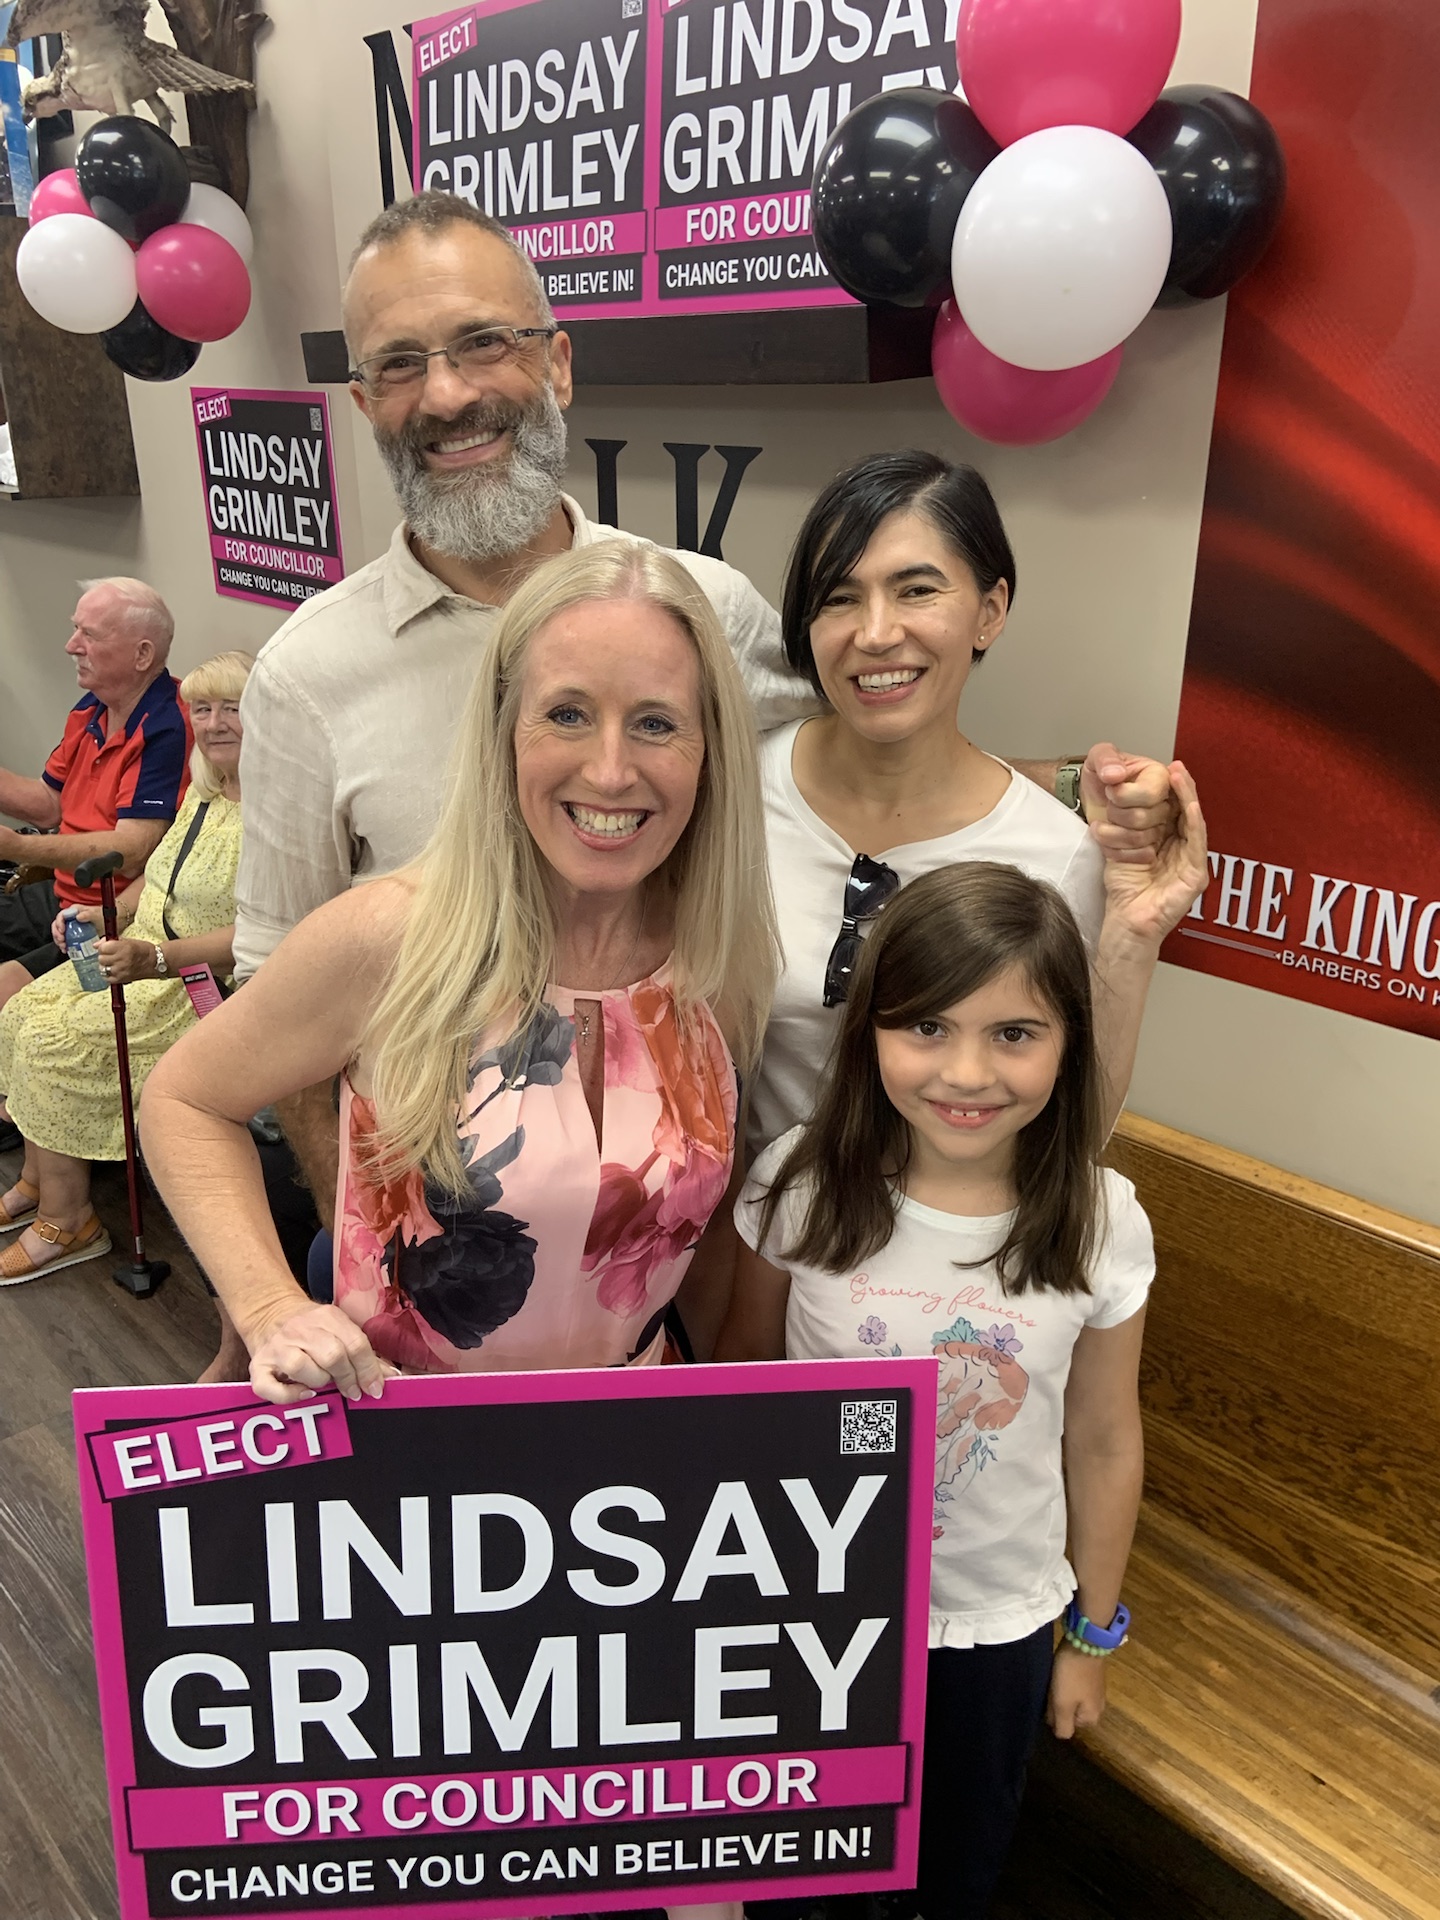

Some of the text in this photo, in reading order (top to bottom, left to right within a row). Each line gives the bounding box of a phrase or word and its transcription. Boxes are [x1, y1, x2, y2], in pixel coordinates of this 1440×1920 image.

[420, 17, 472, 73] ELECT
[428, 29, 640, 147] LINDSAY
[686, 205, 736, 244] FOR
[548, 270, 609, 297] BELIEVE
[612, 268, 634, 293] IN!
[665, 251, 829, 289] CHANGE YOU CAN
[196, 395, 228, 424] ELECT
[205, 429, 323, 489] LINDSAY
[209, 484, 330, 549] GRIMLEY
[220, 567, 254, 588] CHANGE
[253, 574, 271, 591] YOU
[271, 578, 290, 596] CAN
[224, 539, 326, 578] FOR COUNCILLOR
[1281, 949, 1382, 990] BARBERS
[1387, 978, 1426, 1002] ON
[850, 1272, 1037, 1328] Growing flowers
[114, 1403, 329, 1489] ELECT
[158, 1474, 888, 1628] LINDSAY
[142, 1617, 890, 1769] GRIMLEY
[222, 1758, 818, 1839] FOR COUNCILLOR
[170, 1826, 872, 1903] CHANGE YOU CAN BELIEVE IN!
